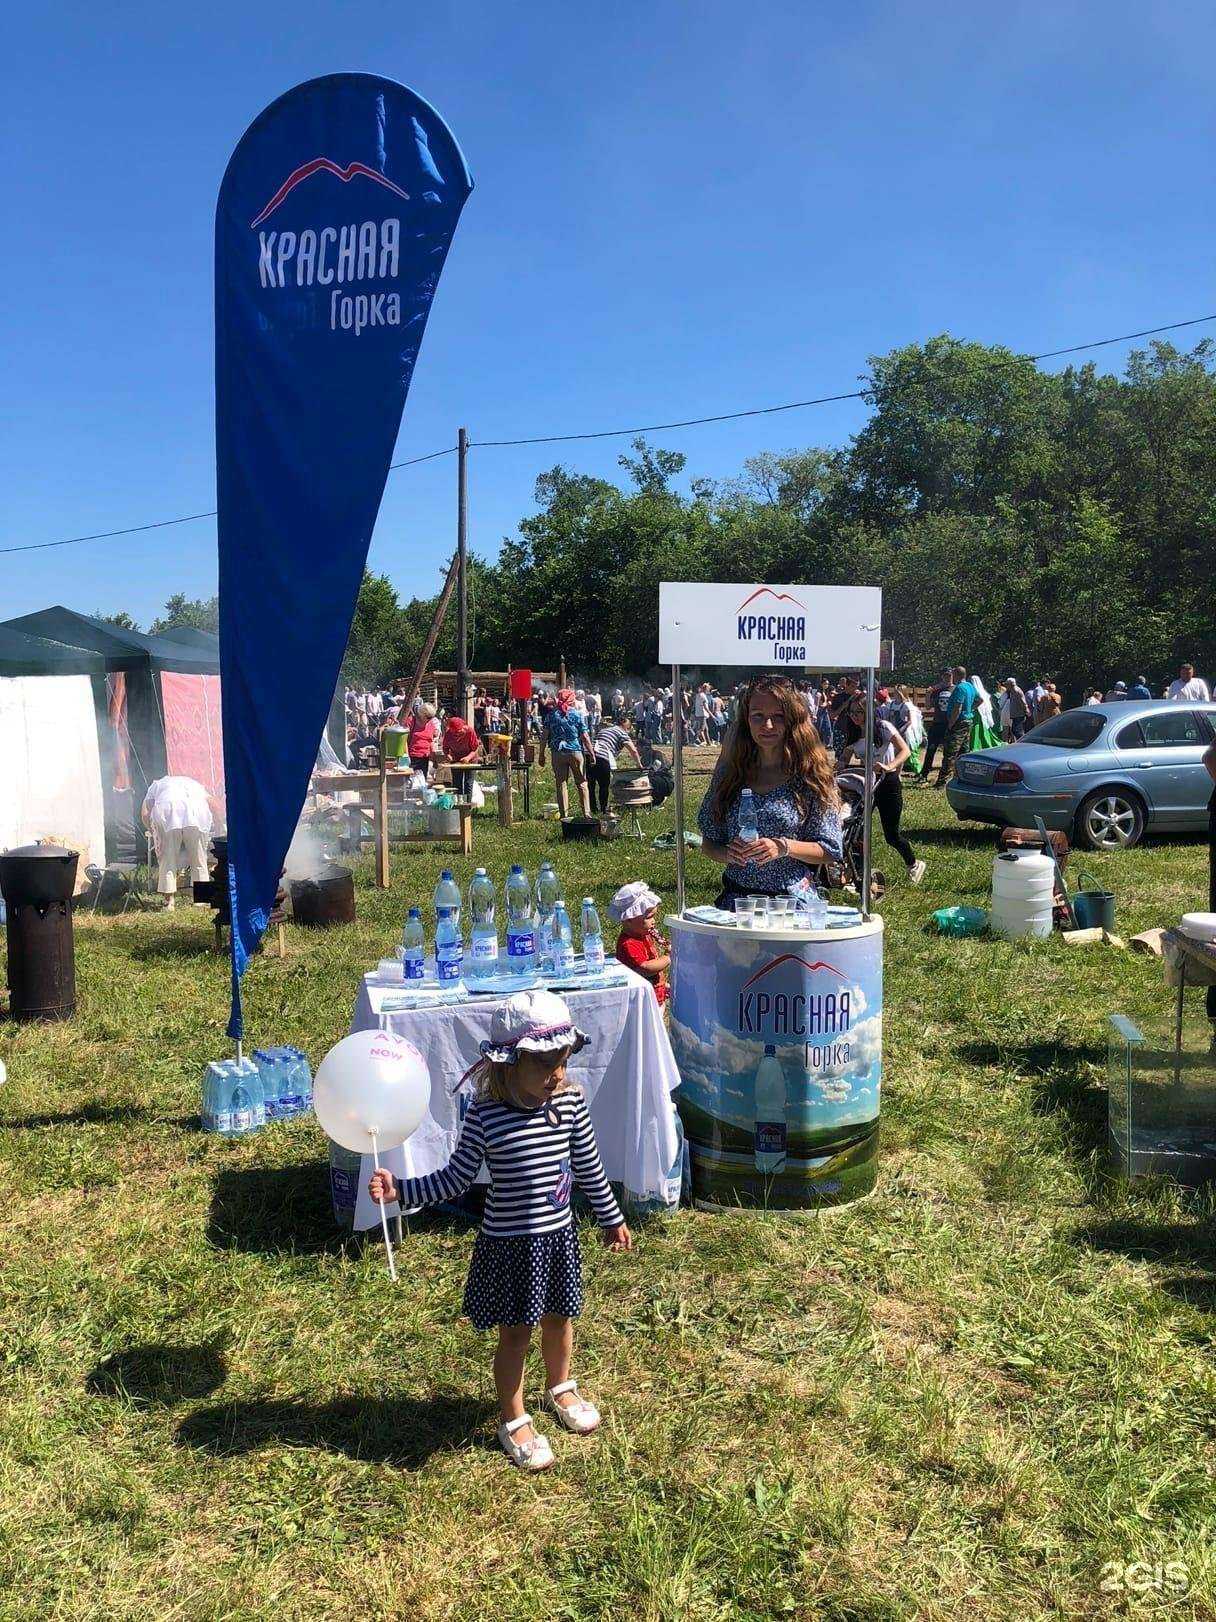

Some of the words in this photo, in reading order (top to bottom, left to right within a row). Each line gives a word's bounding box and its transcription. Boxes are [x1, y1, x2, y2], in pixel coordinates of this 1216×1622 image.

[258, 217, 400, 288] КРАСНАЯ
[331, 289, 400, 336] Горка
[737, 615, 805, 641] КРАСНАЯ
[774, 643, 806, 663] Горка
[738, 991, 850, 1034] КРАСНАЯ
[804, 1040, 851, 1072] Горка
